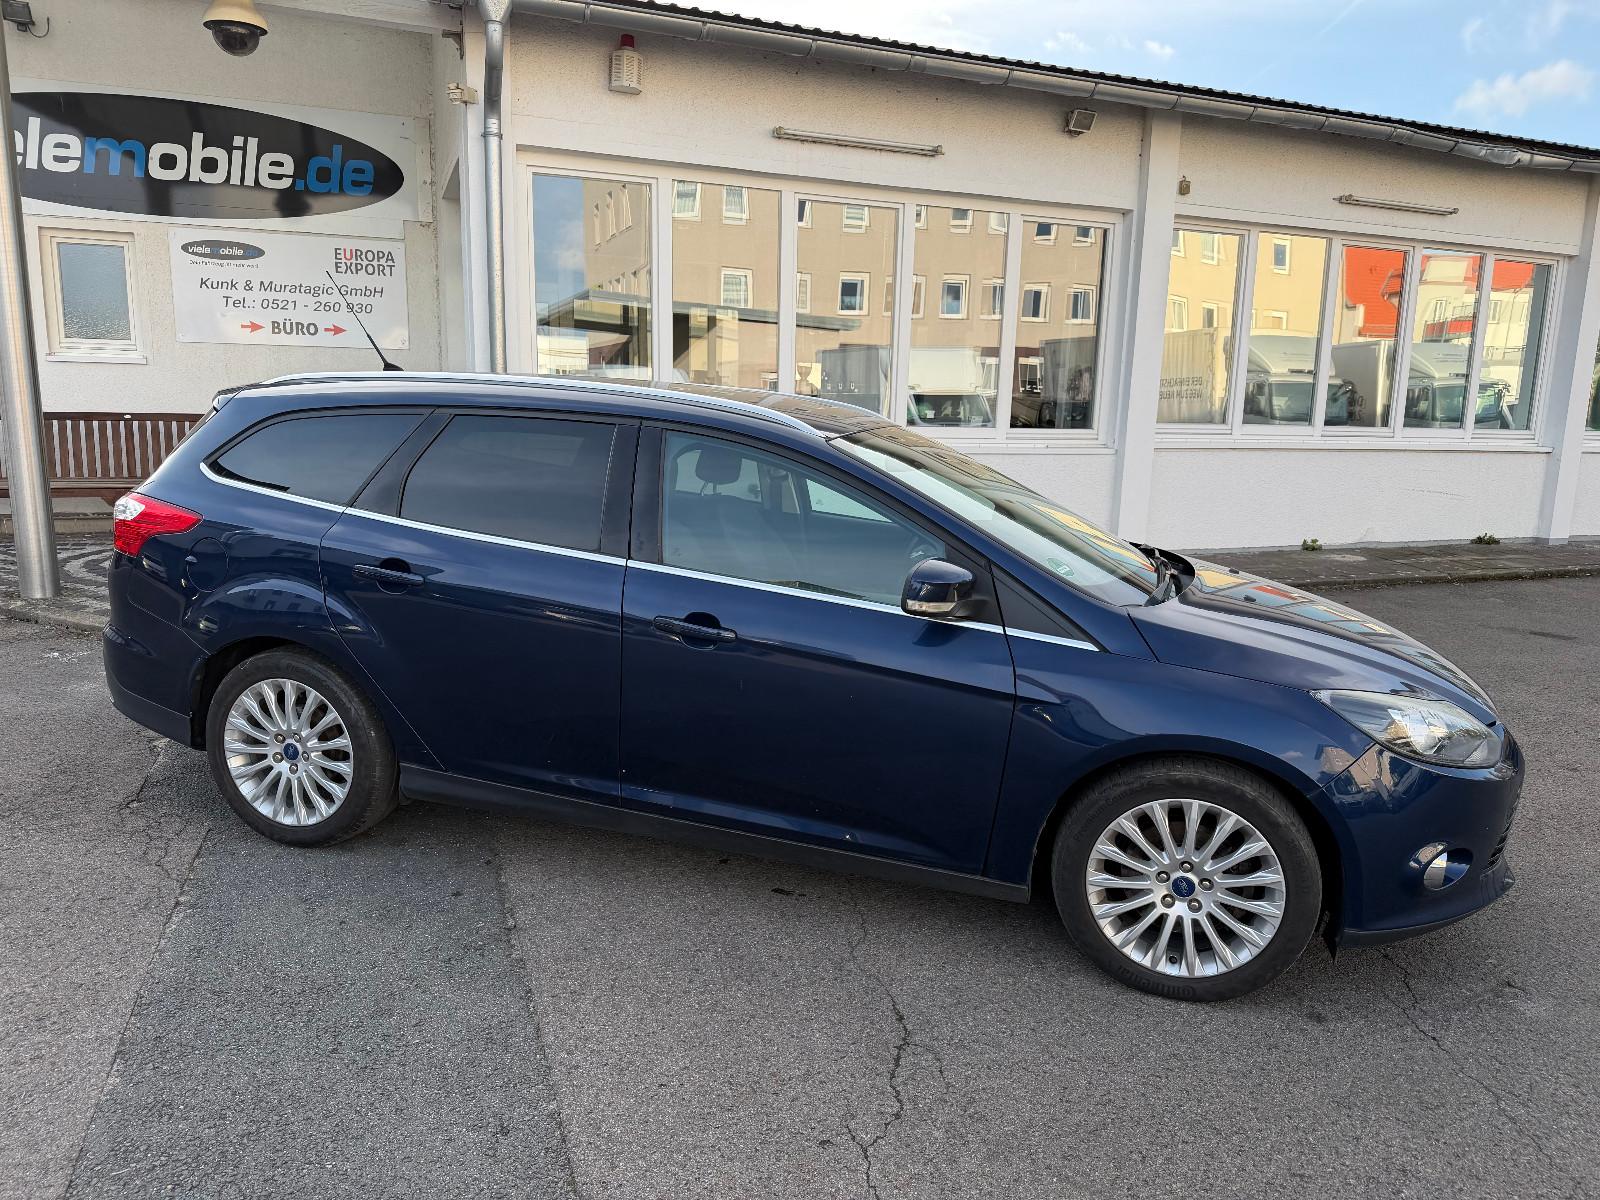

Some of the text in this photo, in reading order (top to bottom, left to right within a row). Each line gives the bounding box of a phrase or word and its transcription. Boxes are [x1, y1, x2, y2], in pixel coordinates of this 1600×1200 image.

[334, 247, 396, 264] EUROPA
[335, 261, 396, 277] EXPORT
[200, 277, 384, 298] Kunk & Muratagic GmbH
[222, 295, 256, 309] Tel.:
[261, 298, 297, 311] 0521
[313, 301, 341, 313] 260
[346, 303, 373, 314] 930
[271, 318, 319, 336] BÜRO
